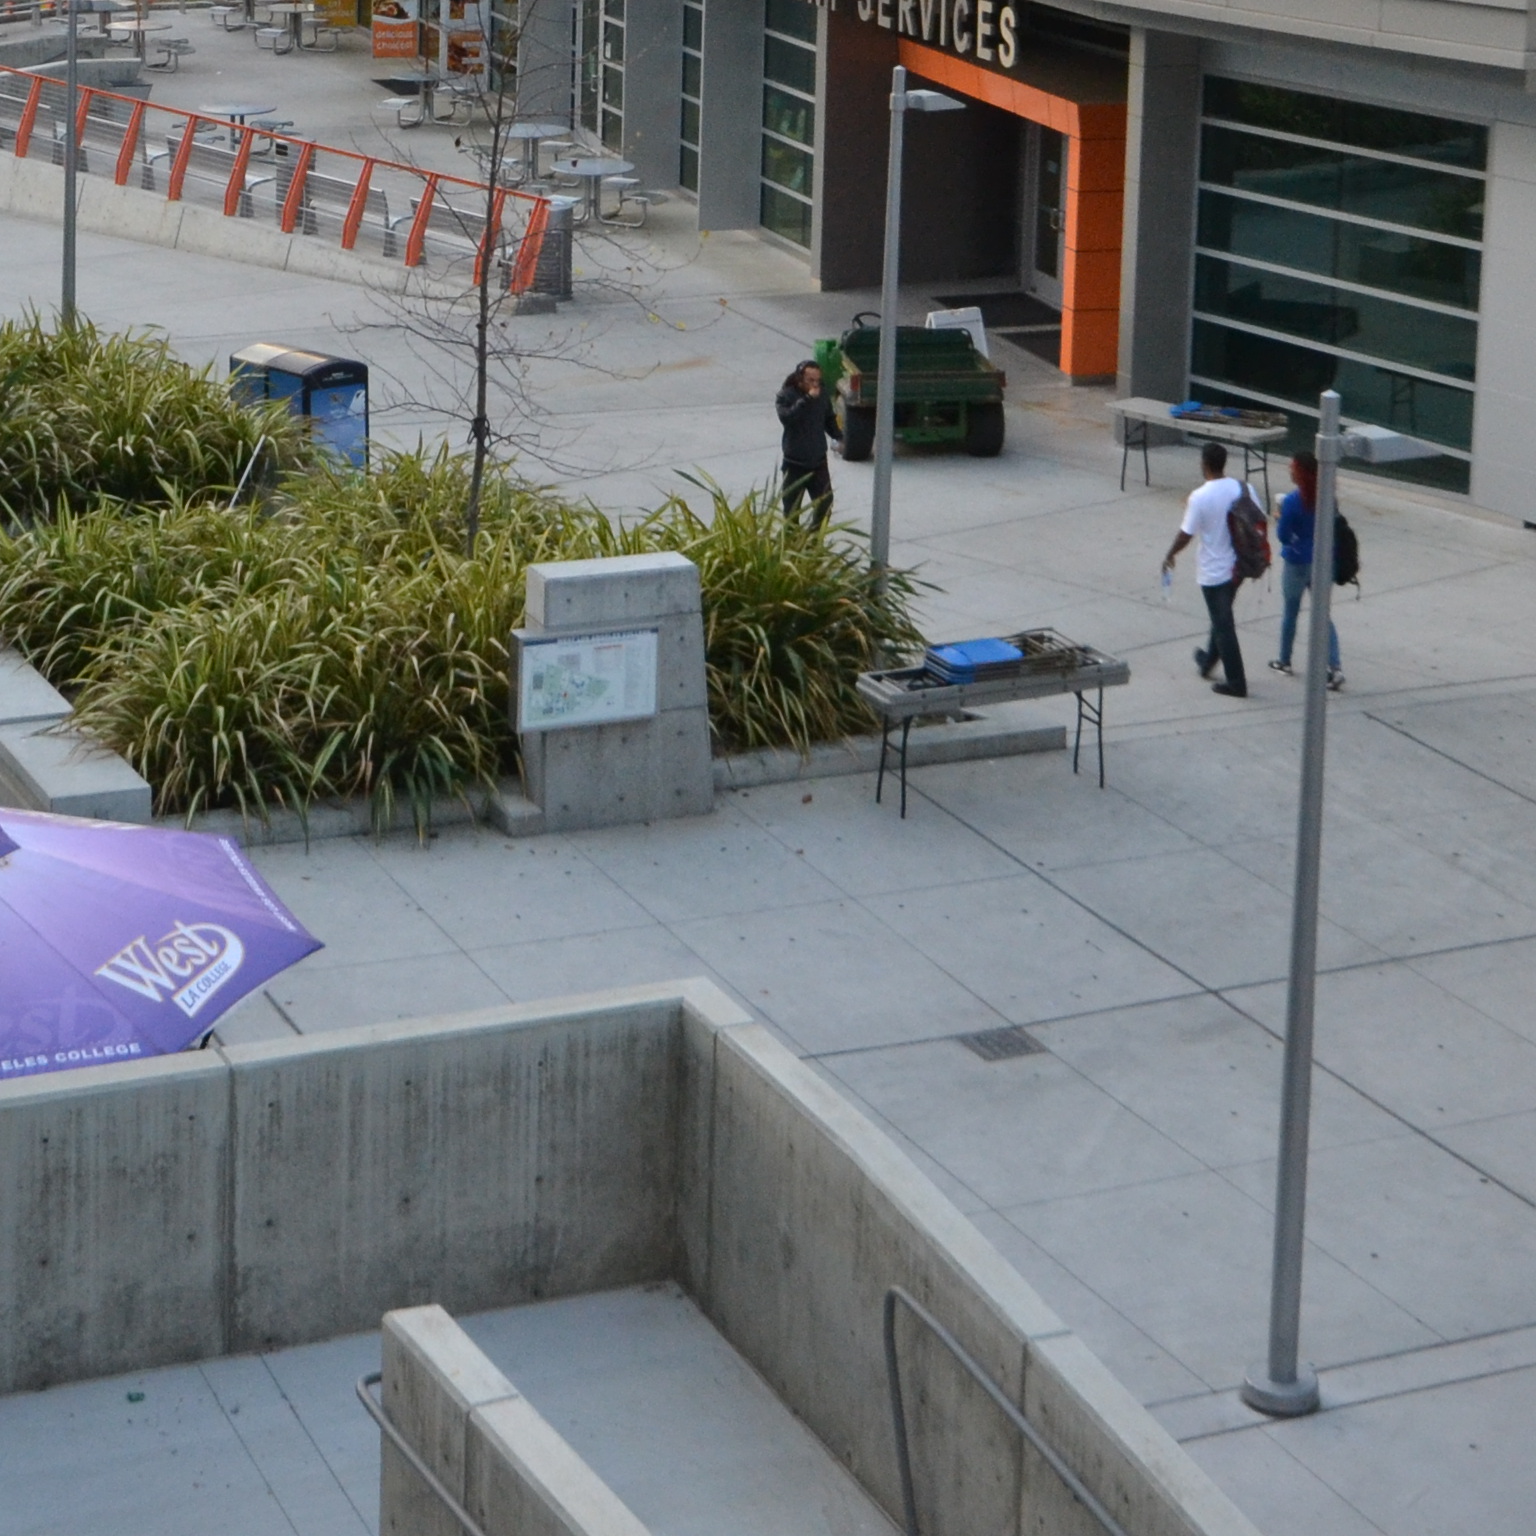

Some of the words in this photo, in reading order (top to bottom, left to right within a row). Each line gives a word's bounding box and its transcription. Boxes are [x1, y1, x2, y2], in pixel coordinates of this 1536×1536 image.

[94, 919, 221, 1003] West
[180, 989, 201, 1009] LA
[196, 961, 232, 994] COLLEGE
[55, 1041, 143, 1063] COLLEGE
